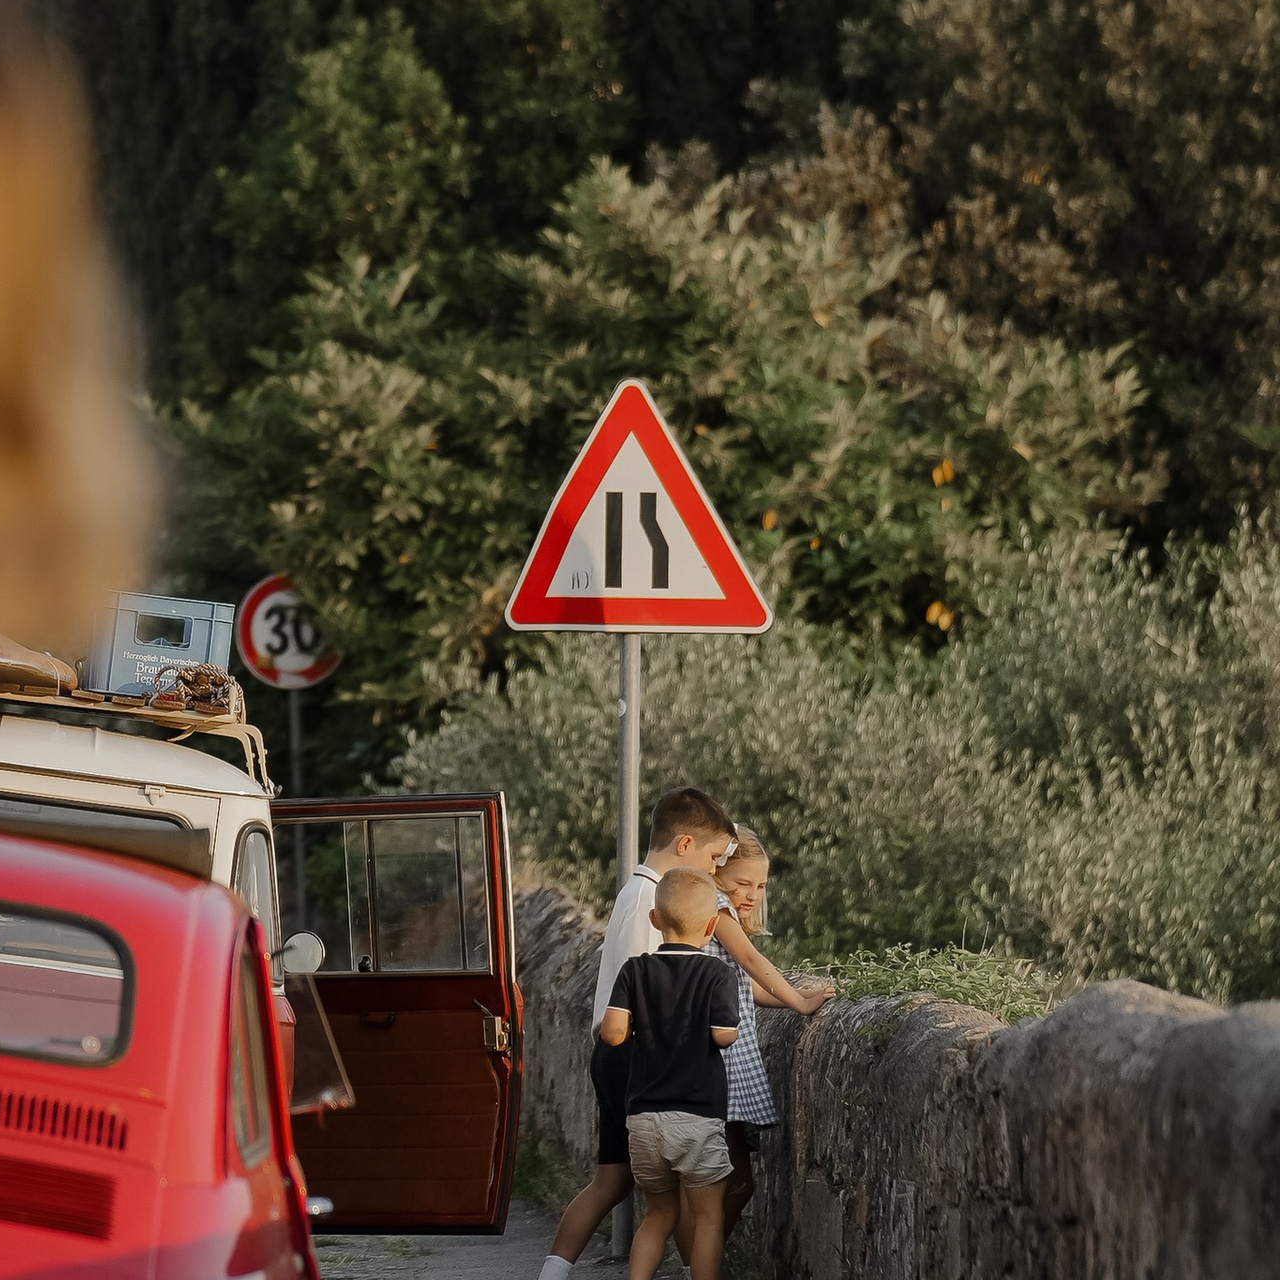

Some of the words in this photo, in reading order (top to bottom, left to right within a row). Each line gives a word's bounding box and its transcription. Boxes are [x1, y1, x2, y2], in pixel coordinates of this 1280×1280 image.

[264, 602, 322, 656] 30
[123, 650, 159, 662] Herzoglich
[136, 661, 179, 677] Brauau
